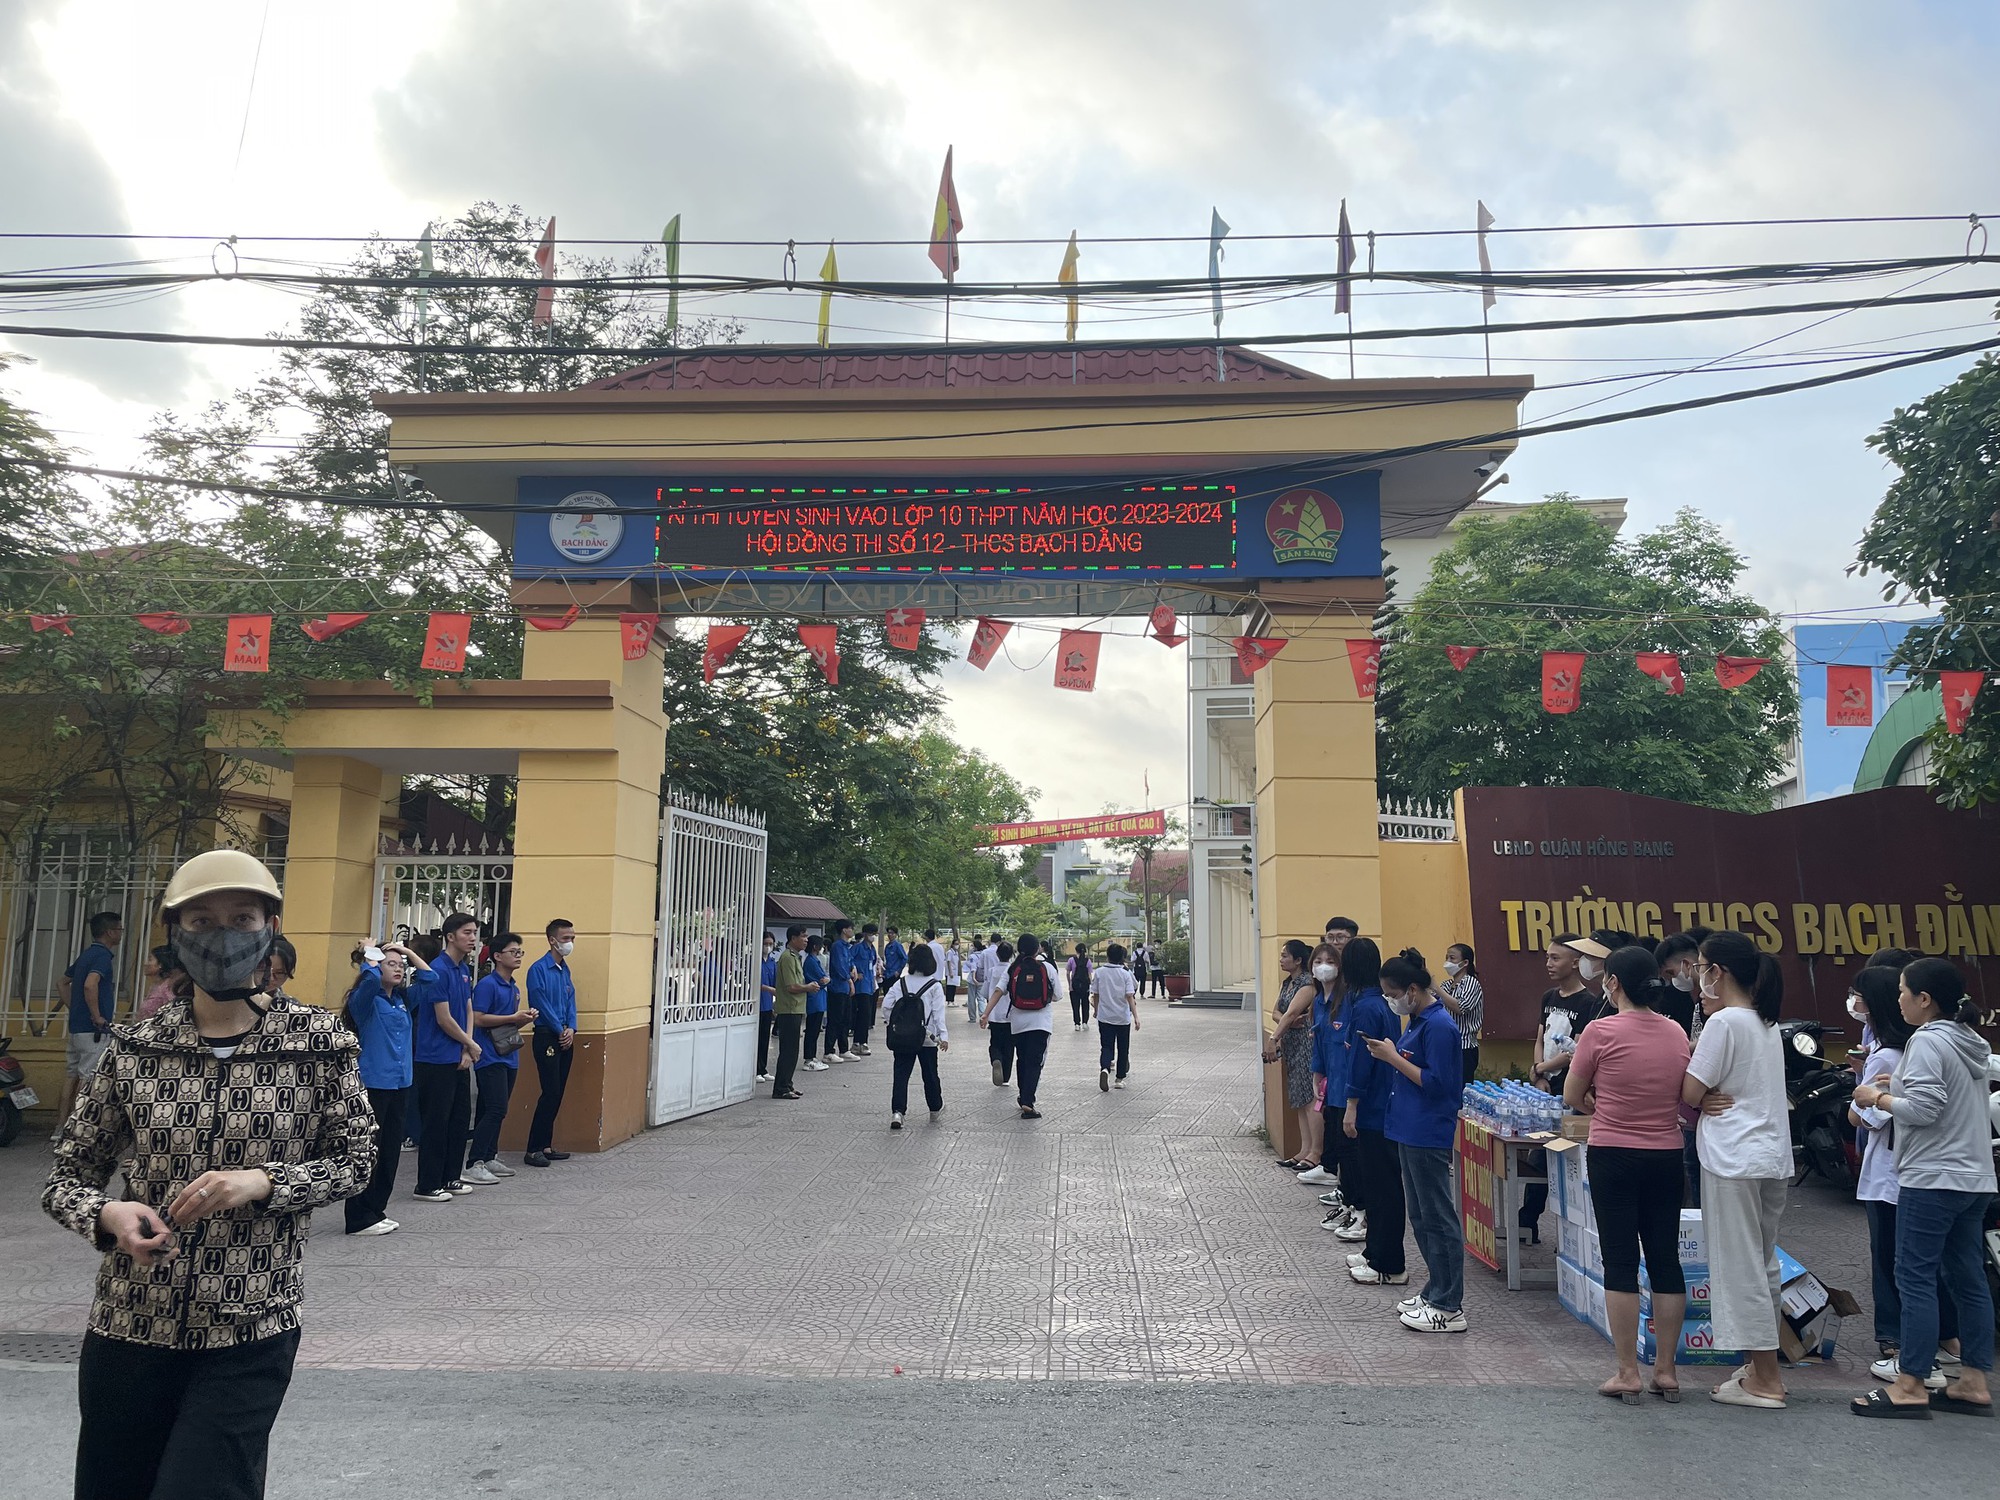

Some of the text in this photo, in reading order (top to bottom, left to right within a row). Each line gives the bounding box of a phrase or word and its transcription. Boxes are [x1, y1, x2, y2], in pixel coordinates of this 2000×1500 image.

[795, 506, 840, 526] SINH
[892, 504, 934, 526] LỚP
[939, 505, 962, 526] 10
[966, 505, 1019, 526] THPT
[1022, 502, 1067, 526] NĂM
[1072, 504, 1117, 527] HỌC
[1121, 502, 1223, 525] 2023-2024
[746, 529, 782, 557] HỘI
[786, 527, 847, 553] ĐỒNG
[851, 533, 882, 553] THI
[887, 528, 918, 554] SỐ
[922, 532, 945, 553] 12
[961, 533, 1015, 553] THCS
[1020, 532, 1077, 557] BẠCH
[1082, 527, 1142, 553] ĐẰNG
[1000, 827, 1019, 841] SINH
[1020, 825, 1038, 840] BÌNH
[1105, 816, 1120, 833] KẾT
[1138, 816, 1155, 830] CAO
[1493, 840, 1536, 857] UBND
[1539, 838, 1583, 859] QUẬN
[1586, 835, 1629, 857] HỒNG
[1500, 884, 1664, 951] TRƯỜNG
[1672, 901, 1783, 955] THCS
[1791, 902, 1906, 966] BẠCH
[1677, 1239, 1698, 1250] rue
[1679, 1251, 1698, 1259] ATER
